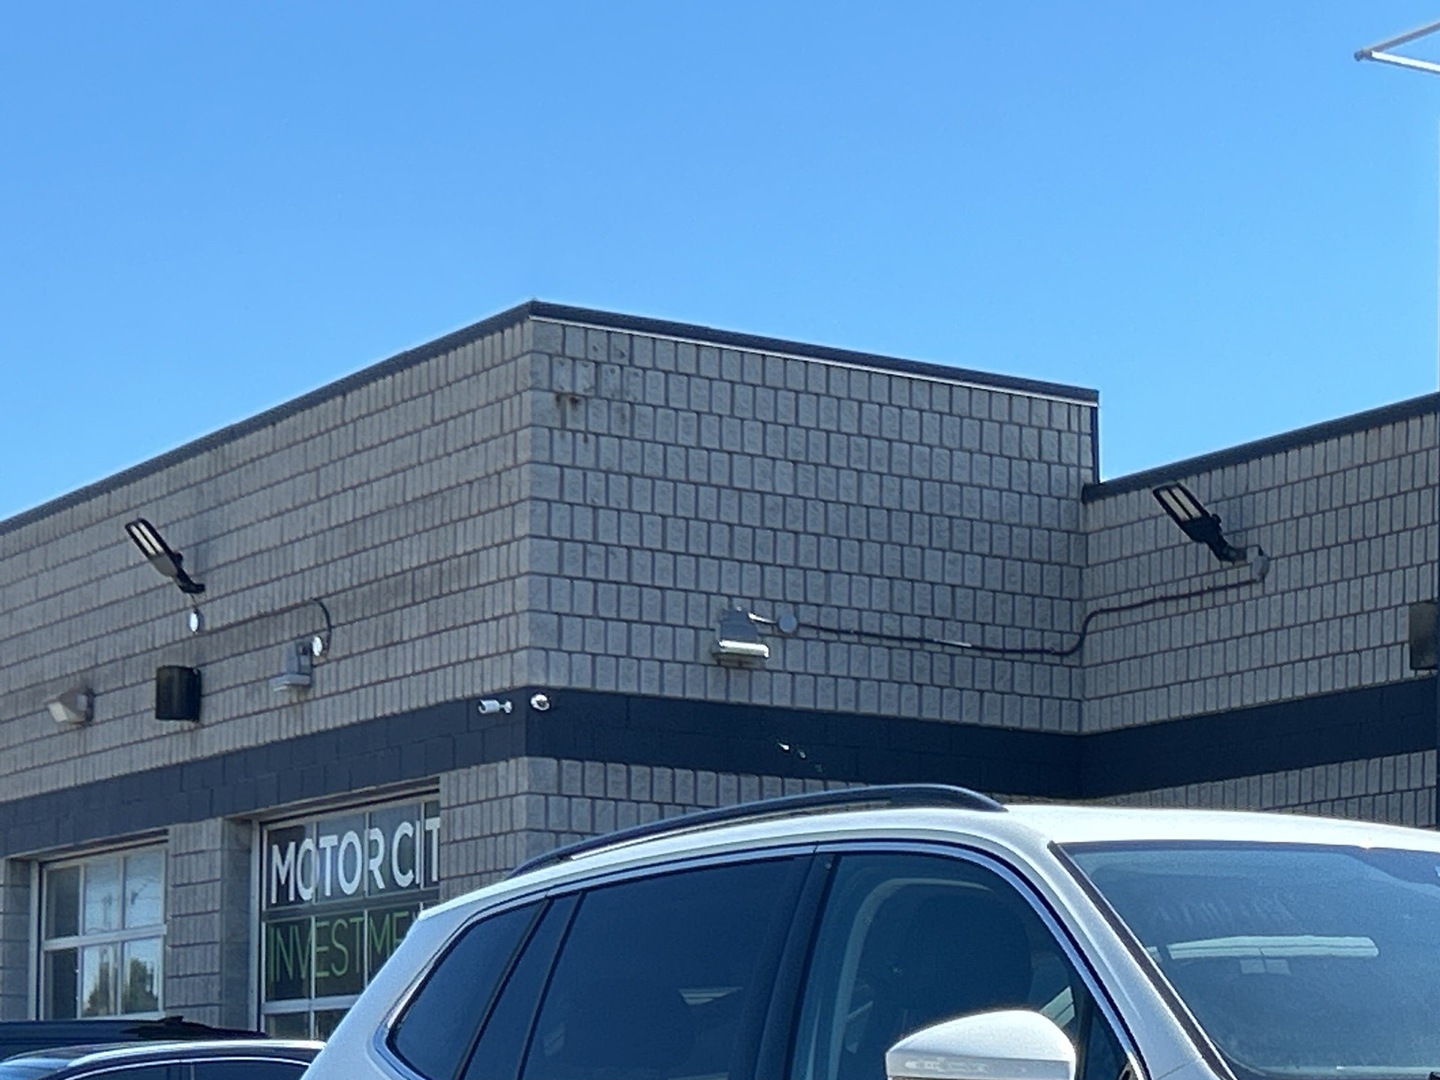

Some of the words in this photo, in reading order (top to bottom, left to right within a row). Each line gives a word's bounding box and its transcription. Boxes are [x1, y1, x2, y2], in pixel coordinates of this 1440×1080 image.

[271, 827, 386, 904] MOTOR
[391, 816, 440, 888] CIT
[268, 910, 417, 983] INVESTME
